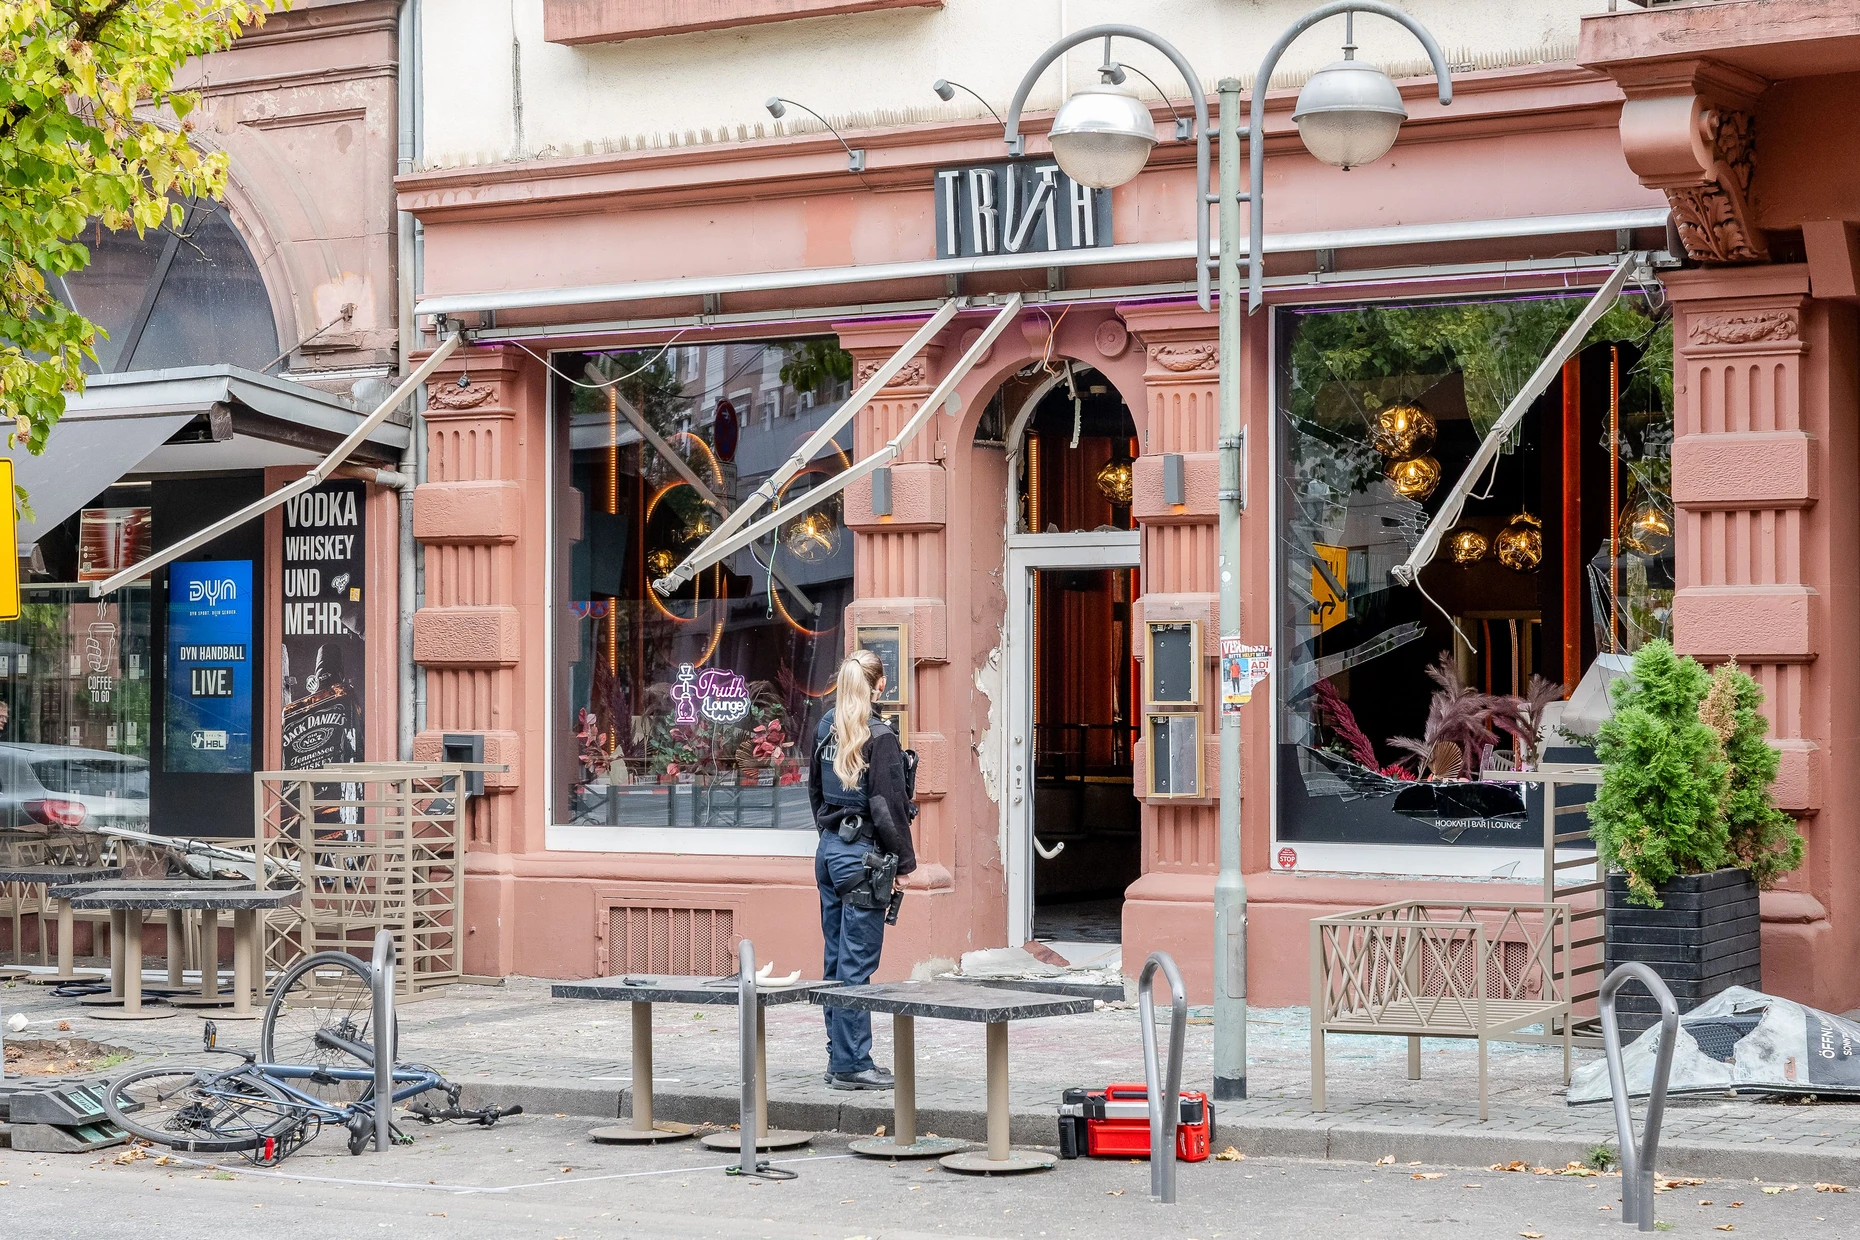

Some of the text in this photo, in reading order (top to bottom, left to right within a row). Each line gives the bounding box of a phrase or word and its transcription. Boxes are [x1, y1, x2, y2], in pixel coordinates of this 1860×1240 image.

[938, 163, 1095, 254] TRUTH
[286, 491, 358, 528] VODKA
[285, 534, 355, 561] WHISKEY
[189, 579, 236, 606] DYN
[284, 568, 321, 597] UND
[285, 602, 348, 635] MEHR.
[180, 646, 245, 660] DYN HANDBALL
[1251, 661, 1269, 669] ADI
[87, 676, 112, 690] COFFEE
[192, 669, 232, 695] LIVE.
[698, 670, 747, 699] Truth
[91, 690, 110, 703] TO GO
[706, 697, 743, 713] Lounge
[205, 740, 225, 748] HBL
[282, 723, 307, 747] JACK
[1435, 819, 1467, 828] HOOKAH
[1491, 821, 1522, 829] LOUNGE
